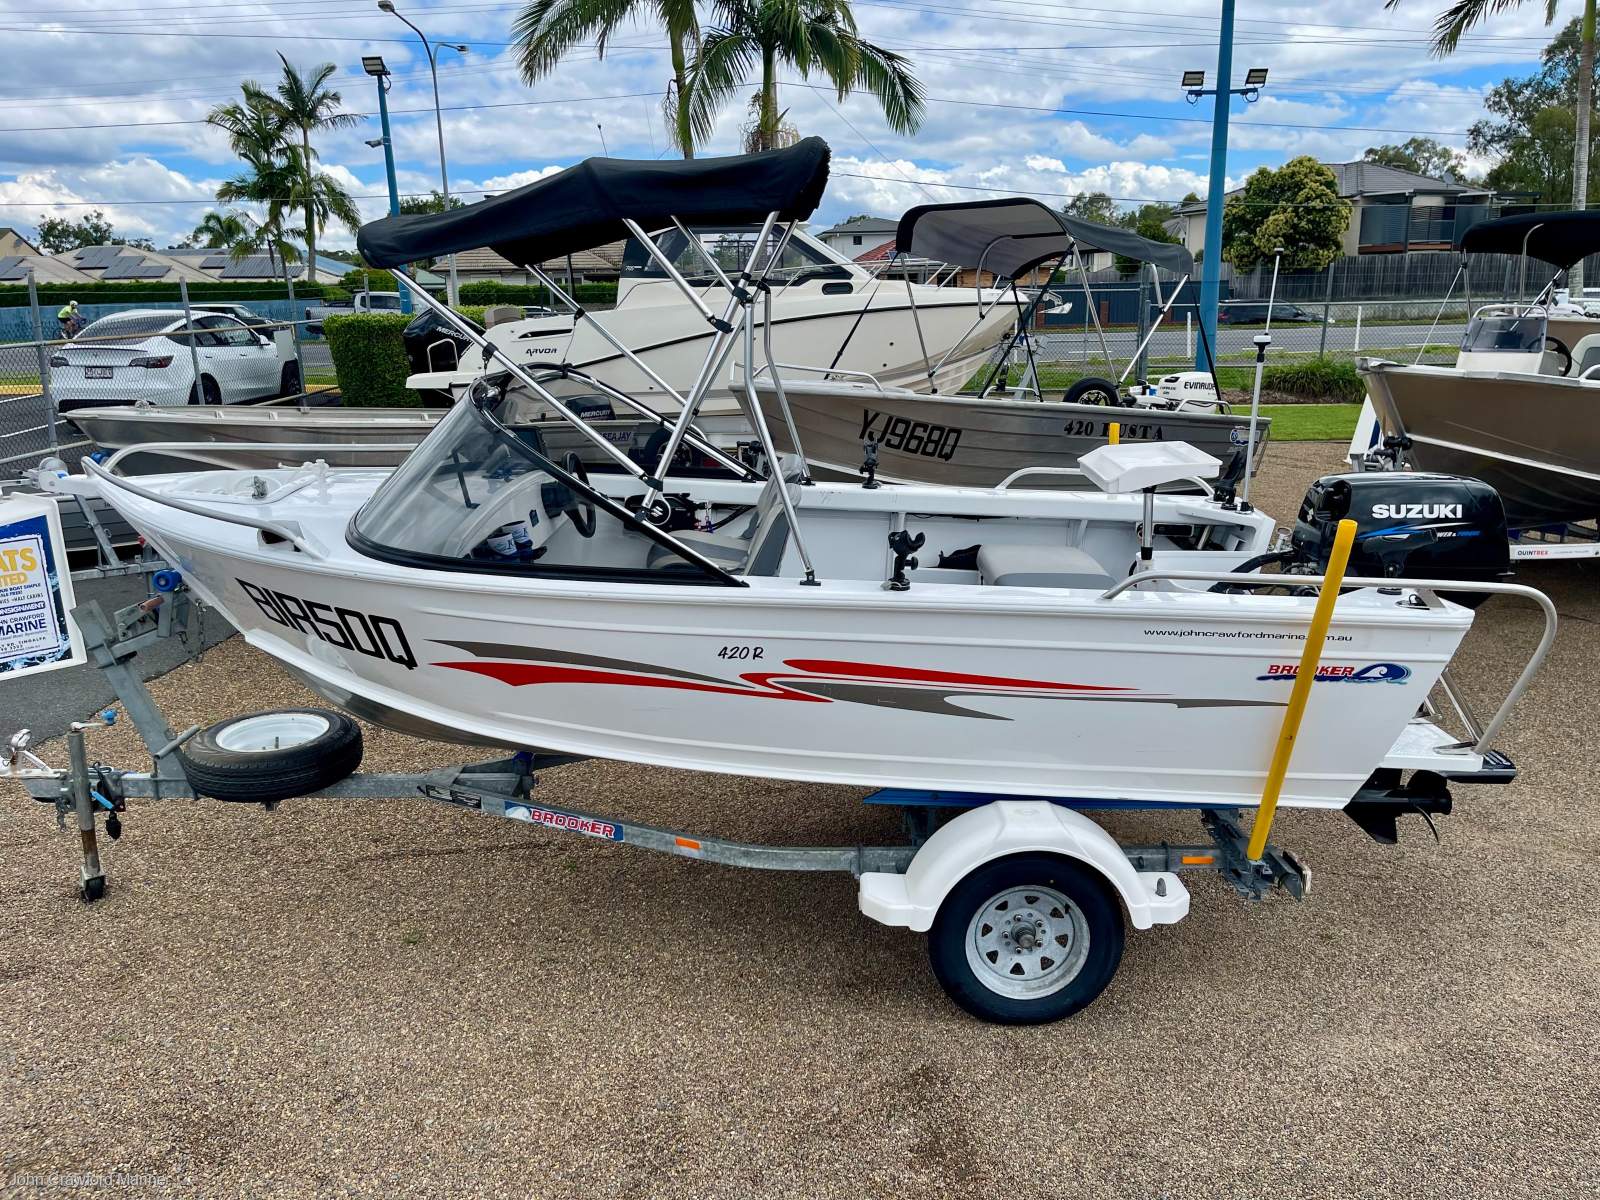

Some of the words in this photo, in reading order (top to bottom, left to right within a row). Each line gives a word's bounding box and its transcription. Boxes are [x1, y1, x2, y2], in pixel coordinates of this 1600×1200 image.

[436, 326, 472, 343] MERCUR
[526, 348, 557, 357] ARVOR
[580, 409, 611, 418] MERCURY
[1064, 419, 1095, 436] 420
[618, 432, 631, 441] JAY
[859, 408, 962, 462] YJ968Q
[1372, 504, 1463, 519] SUZUKI
[10, 612, 45, 623] CRAWFORD
[1143, 629, 1353, 642] www.johncrawfordmarine.m.au
[717, 646, 750, 660] 420
[752, 646, 764, 660] R
[1268, 664, 1355, 677] BRKER
[531, 809, 615, 838] BROOKER
